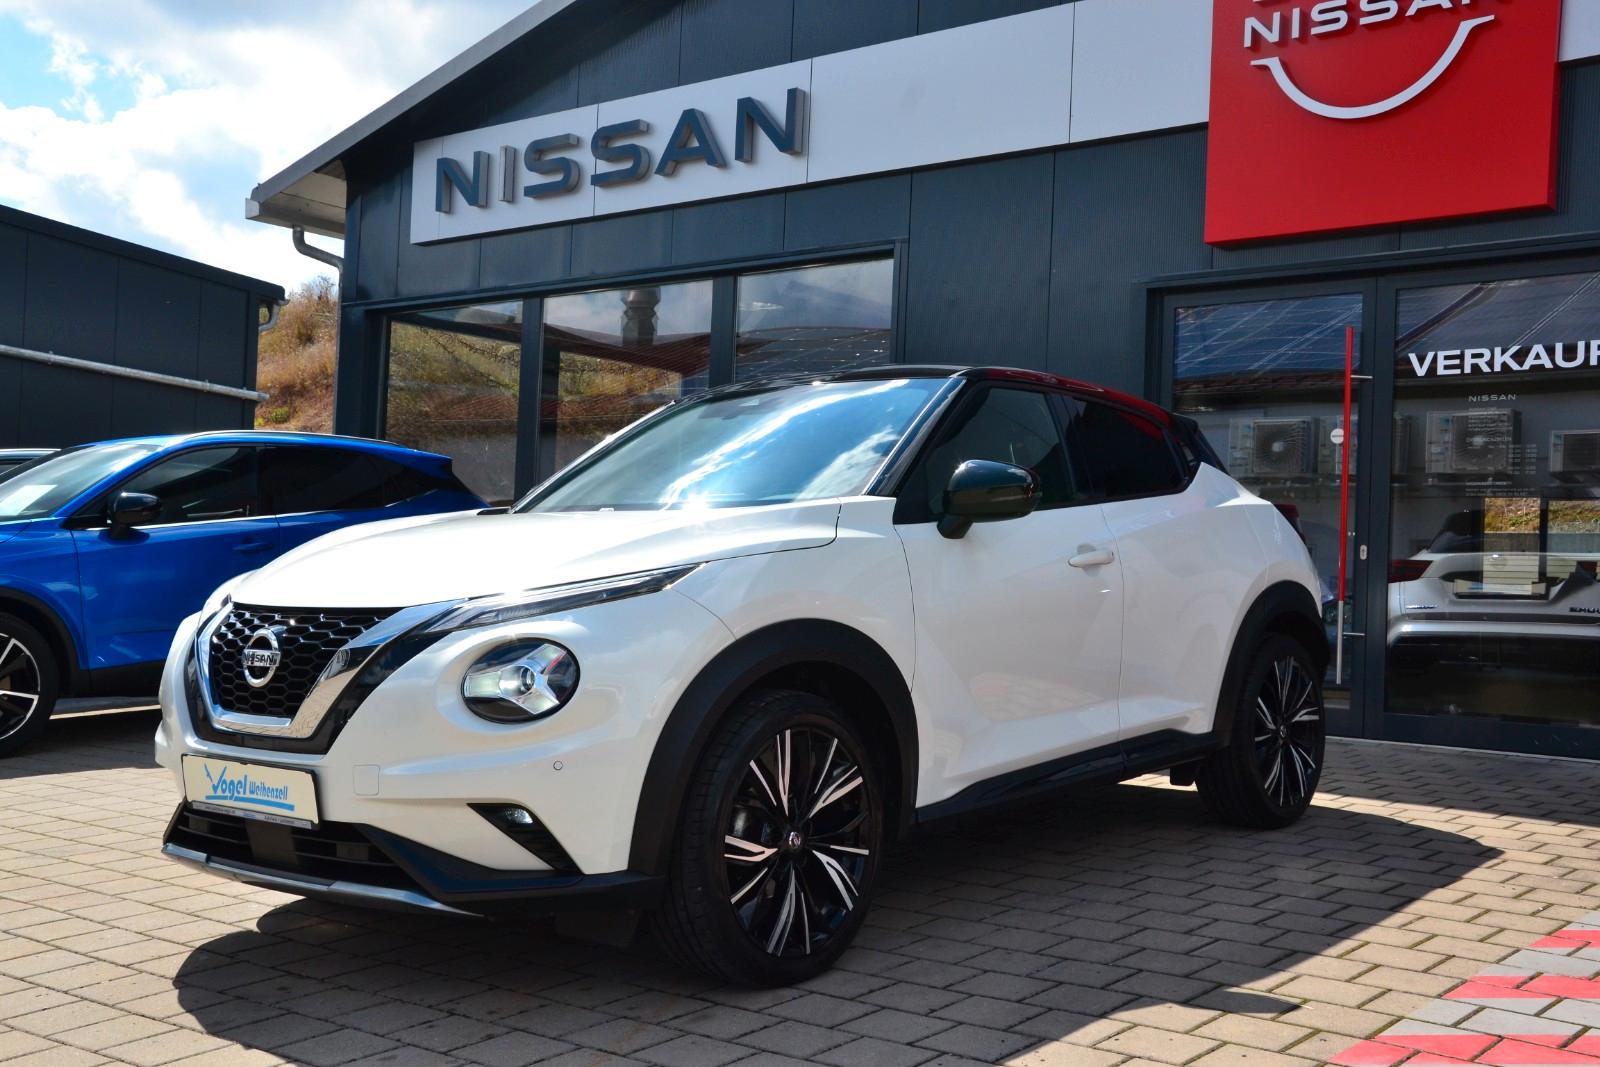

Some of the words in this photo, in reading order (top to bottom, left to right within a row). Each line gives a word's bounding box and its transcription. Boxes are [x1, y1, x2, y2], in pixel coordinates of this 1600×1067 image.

[1243, 0, 1470, 48] NISSA
[435, 87, 807, 214] NISSAN
[1468, 393, 1516, 402] NISSAN
[204, 763, 247, 800] Vogel
[249, 780, 289, 801] Weihenzell
